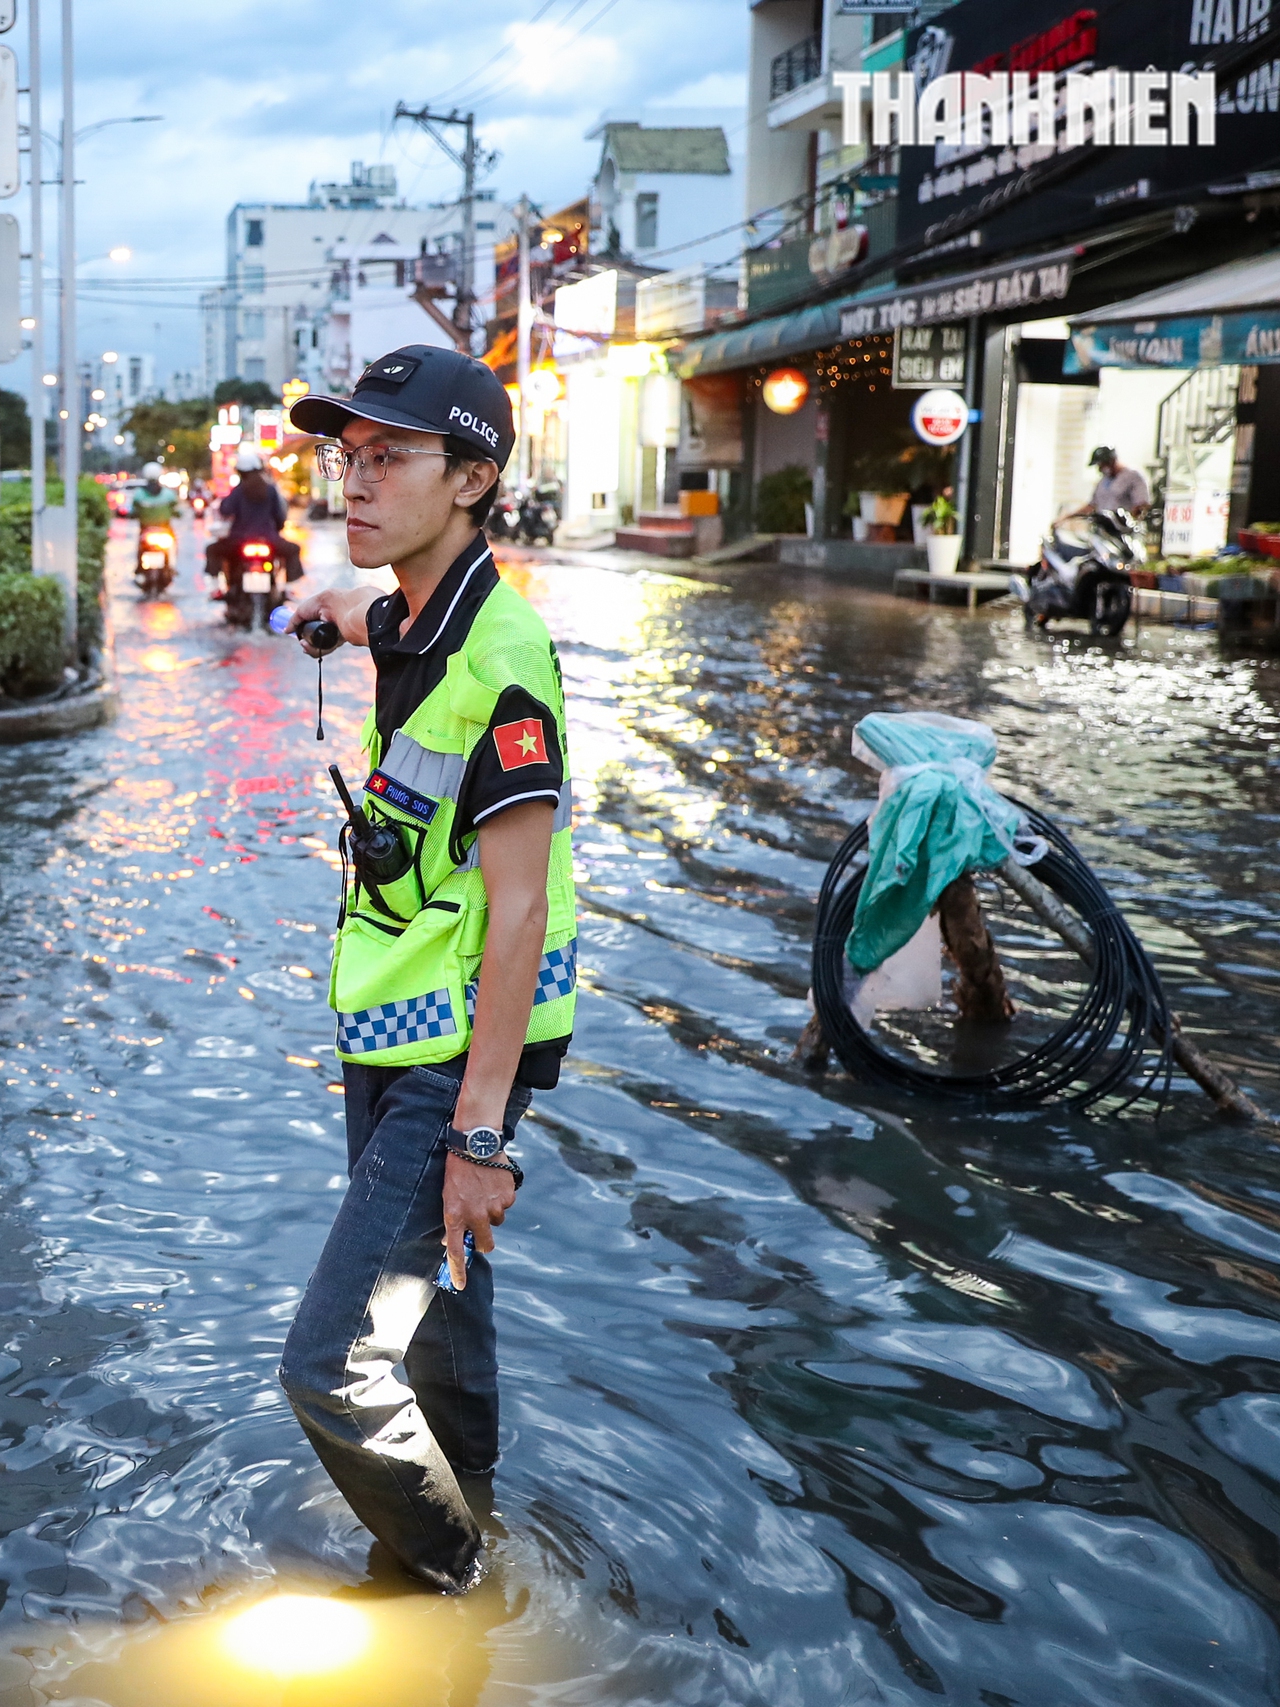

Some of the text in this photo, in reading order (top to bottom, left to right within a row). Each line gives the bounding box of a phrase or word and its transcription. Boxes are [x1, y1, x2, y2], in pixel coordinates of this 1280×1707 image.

[1189, 0, 1271, 45] HAIR
[449, 406, 499, 448] POLICE
[411, 799, 430, 815] SOS
